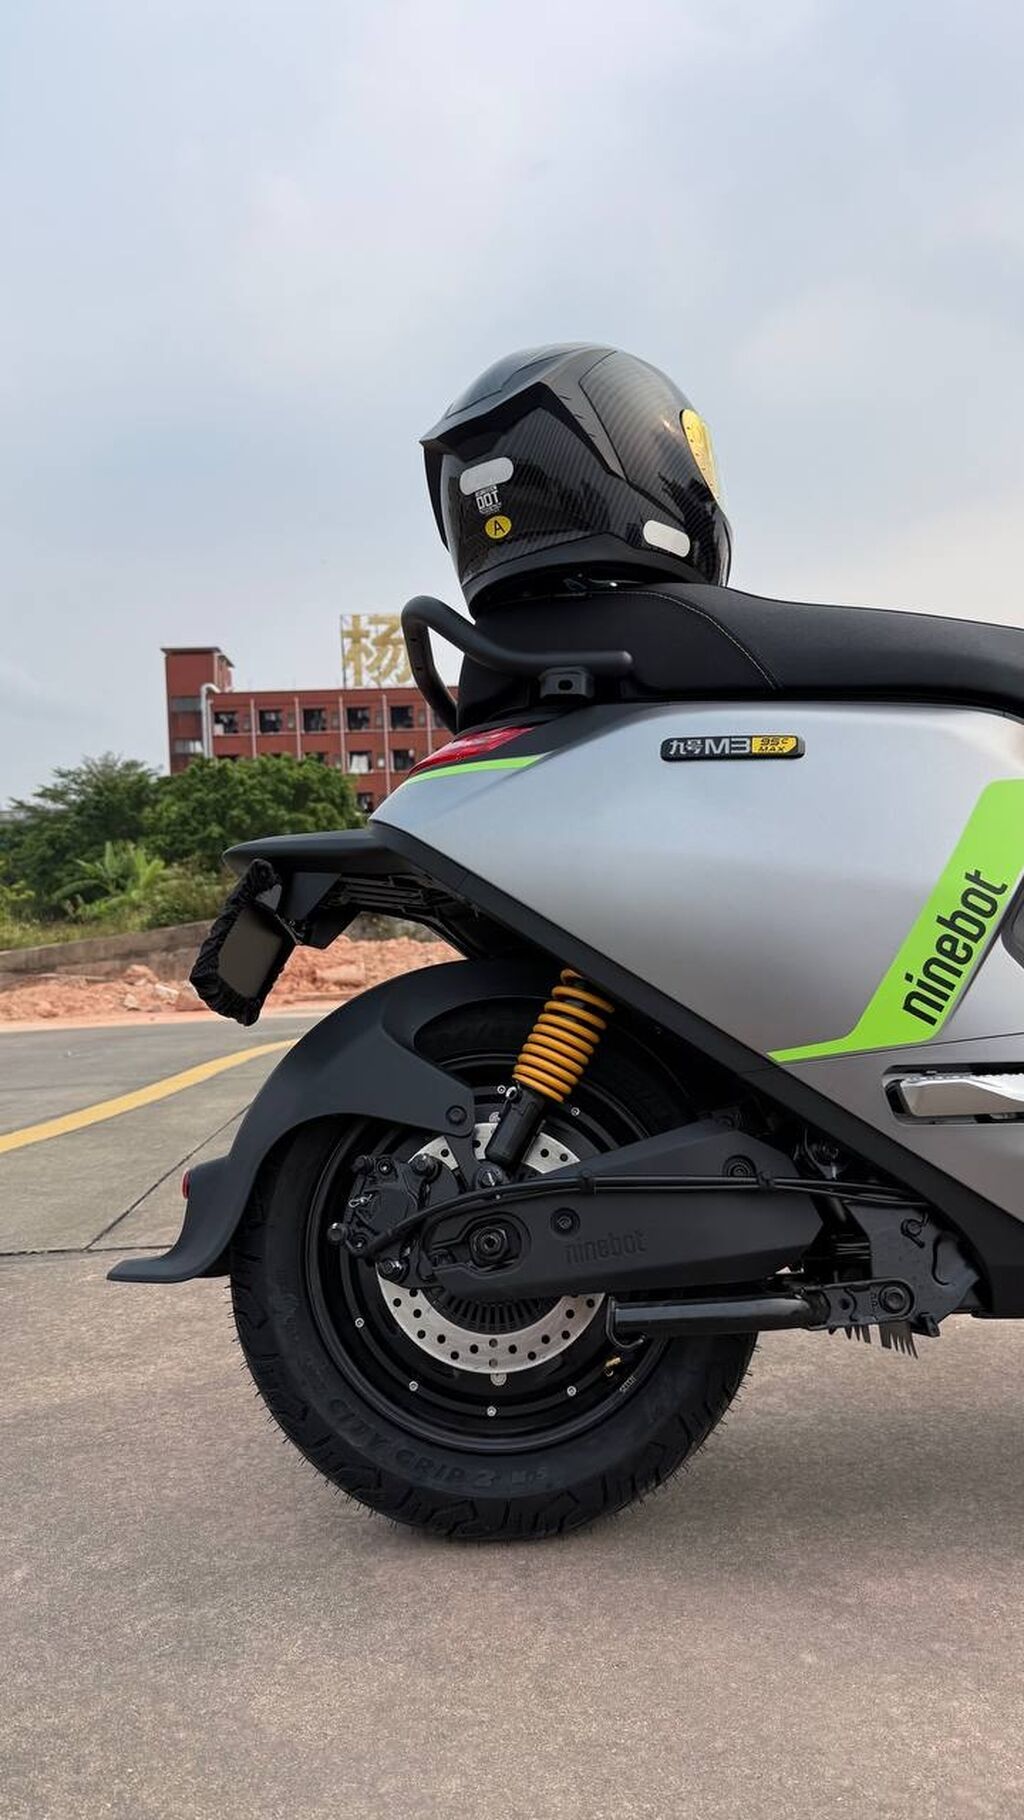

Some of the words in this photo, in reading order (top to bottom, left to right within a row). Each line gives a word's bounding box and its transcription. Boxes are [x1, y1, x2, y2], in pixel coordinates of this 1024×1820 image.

[476, 490, 499, 510] DOT
[494, 520, 506, 536] A
[902, 869, 1008, 1027] ninebot
[565, 1230, 646, 1264] ninebot
